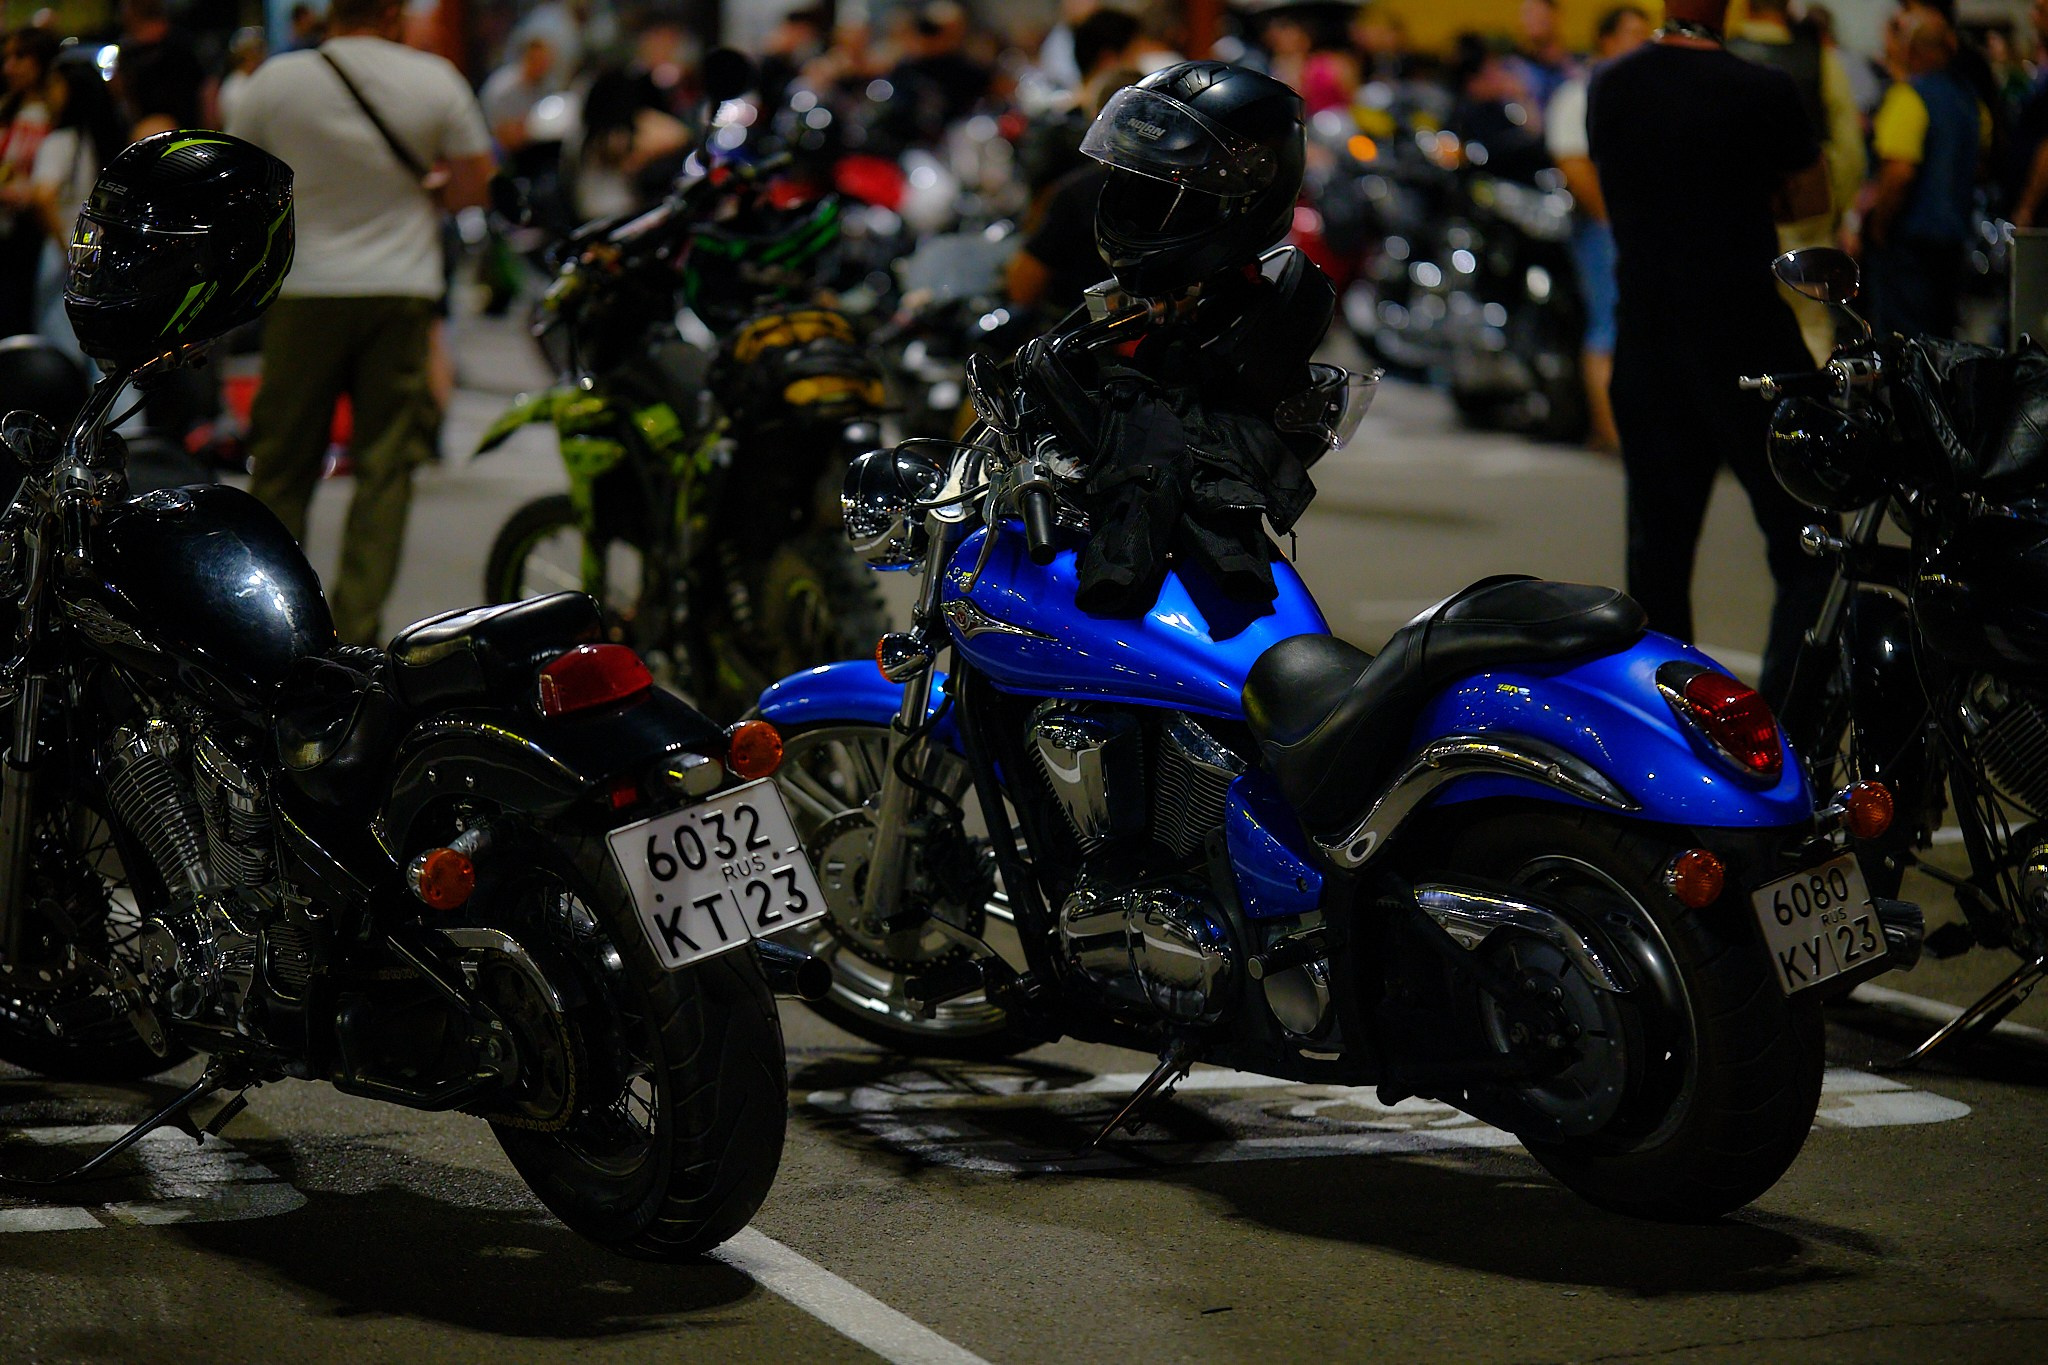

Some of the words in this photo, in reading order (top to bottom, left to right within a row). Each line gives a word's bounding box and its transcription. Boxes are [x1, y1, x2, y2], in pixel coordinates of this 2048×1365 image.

[1127, 117, 1166, 138] NOLAN
[646, 804, 771, 881] 6032
[721, 854, 766, 882] RUS
[652, 892, 728, 958] KT
[745, 864, 809, 928] 23
[1773, 867, 1848, 926] 6080
[1820, 906, 1847, 927] RUS
[1836, 914, 1877, 964] 23
